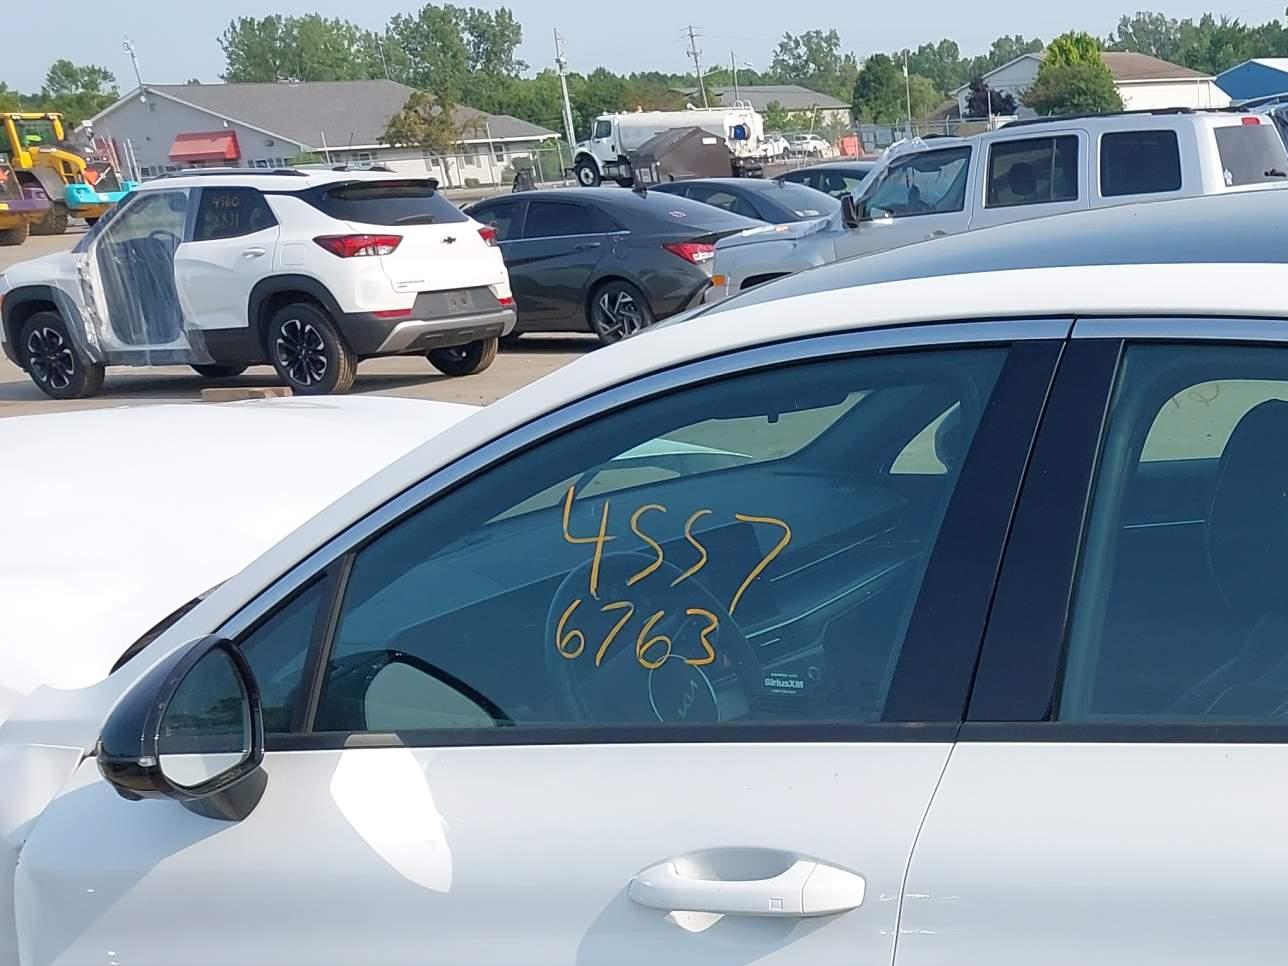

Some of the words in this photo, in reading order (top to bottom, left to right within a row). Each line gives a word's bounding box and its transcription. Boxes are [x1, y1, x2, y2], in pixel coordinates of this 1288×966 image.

[563, 486, 792, 616] 4557
[556, 600, 719, 668] 6763
[763, 677, 804, 689] SiriusXM
